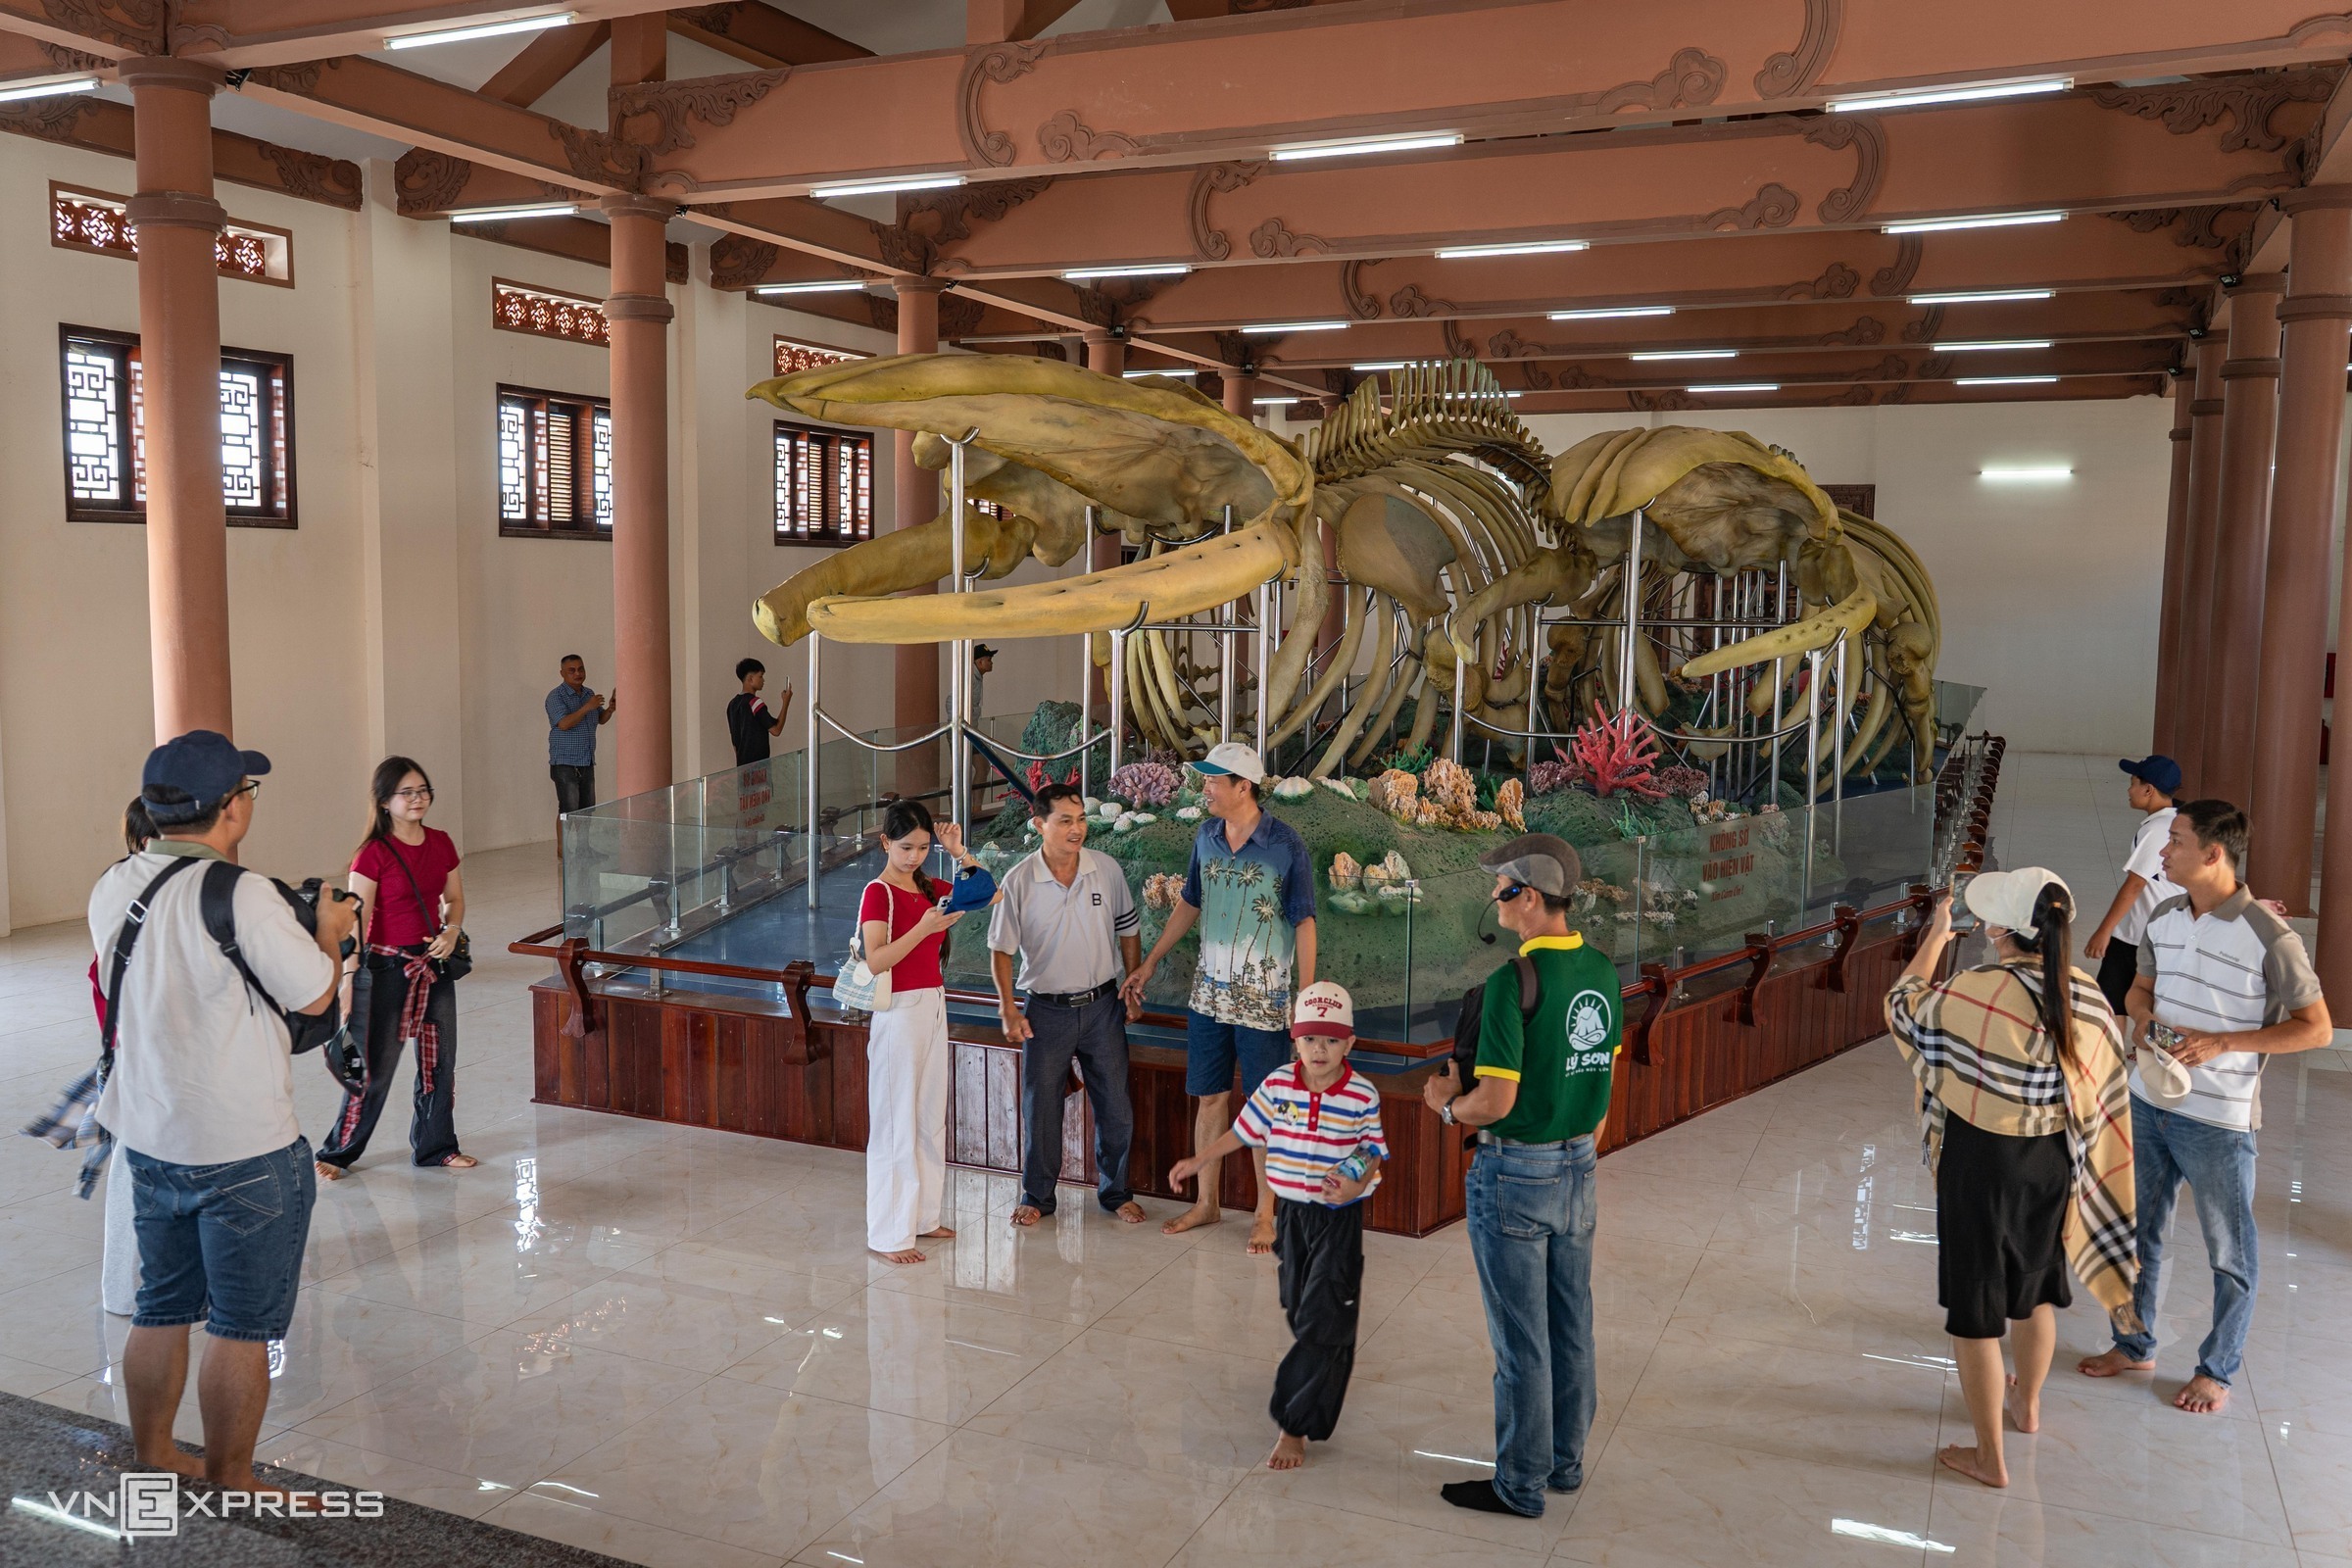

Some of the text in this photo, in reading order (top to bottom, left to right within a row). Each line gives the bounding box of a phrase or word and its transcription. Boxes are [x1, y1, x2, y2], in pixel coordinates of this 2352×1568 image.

[1709, 830, 1737, 853] KHÔNG
[1702, 852, 1754, 882] VÀO HIỆN VẬT
[1092, 893, 1102, 906] B
[1317, 1006, 1328, 1017] 7
[1565, 1053, 1579, 1071] LÝ
[1581, 1052, 1610, 1066] SƠN
